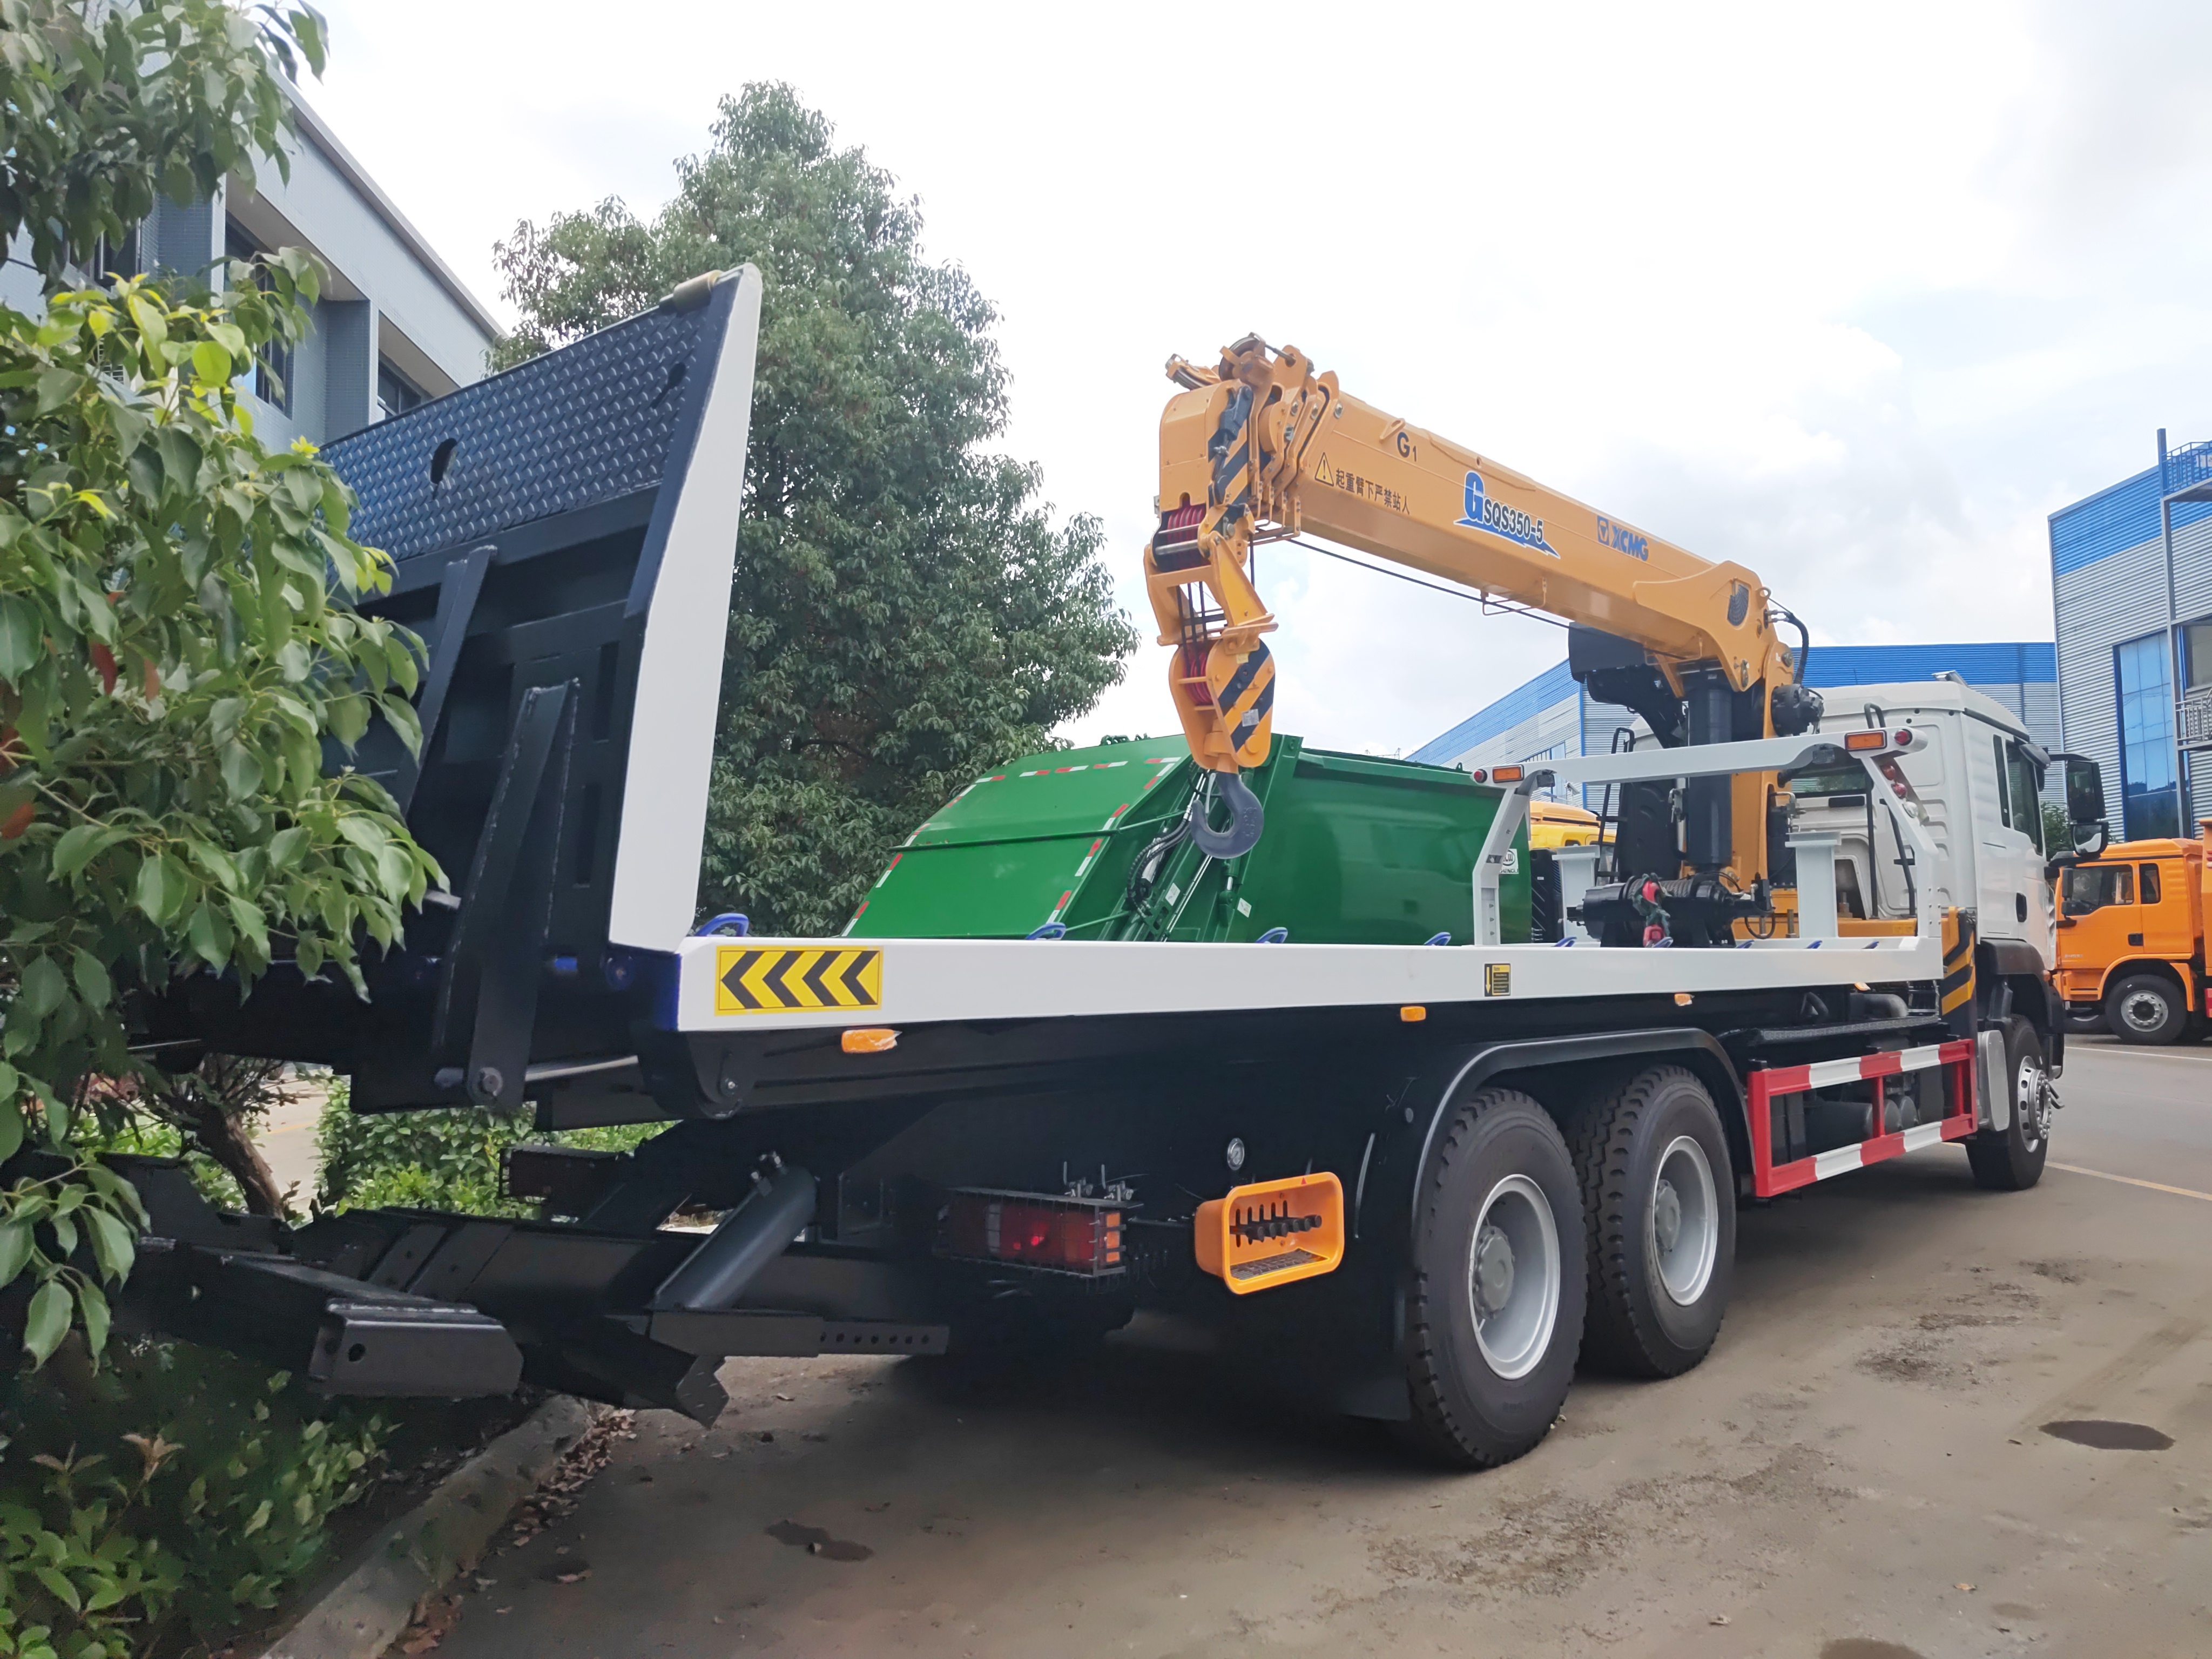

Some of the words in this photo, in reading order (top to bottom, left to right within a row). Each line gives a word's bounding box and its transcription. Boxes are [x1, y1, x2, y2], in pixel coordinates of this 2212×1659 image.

[1336, 468, 1410, 515] 起重臂下严禁站人
[1464, 471, 1543, 543] GSQS350-5
[1613, 525, 1649, 561] XCMG
